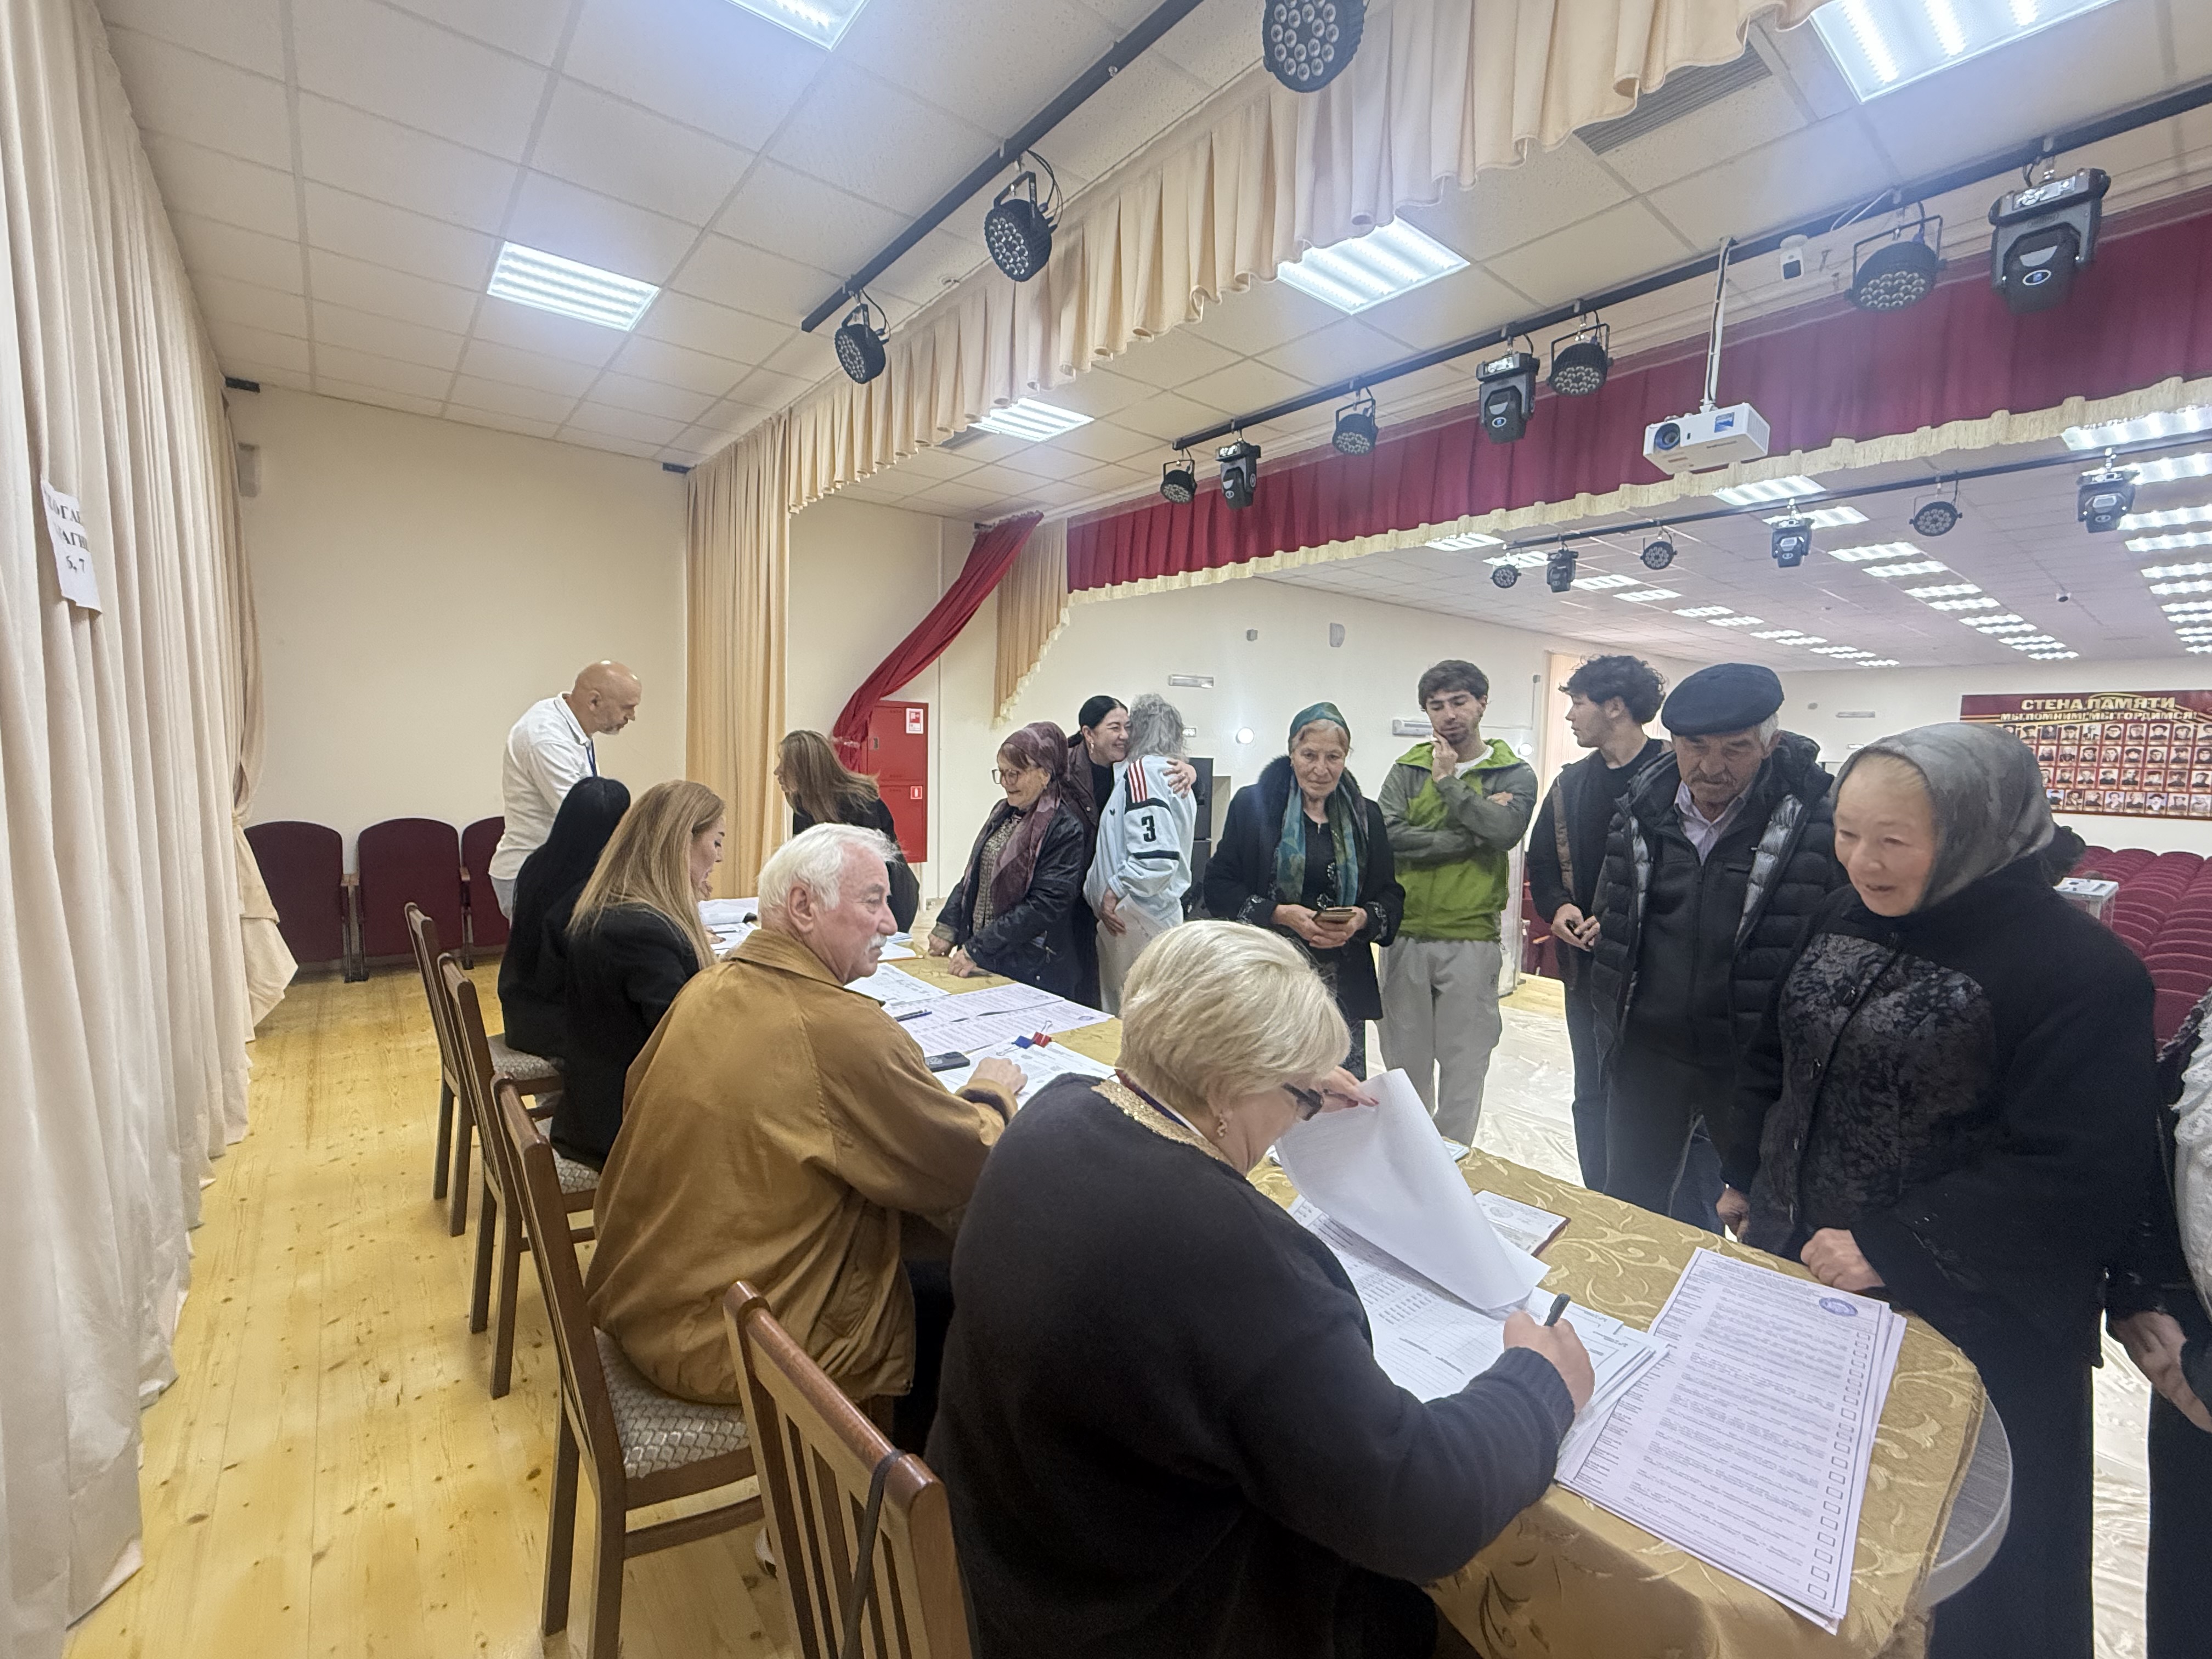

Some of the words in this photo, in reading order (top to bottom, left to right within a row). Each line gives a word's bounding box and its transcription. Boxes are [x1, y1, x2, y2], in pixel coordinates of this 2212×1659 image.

[2021, 698, 2083, 710] СТЕНА
[2087, 697, 2175, 710] ПАМЯТИ
[1141, 815, 1156, 842] 3
